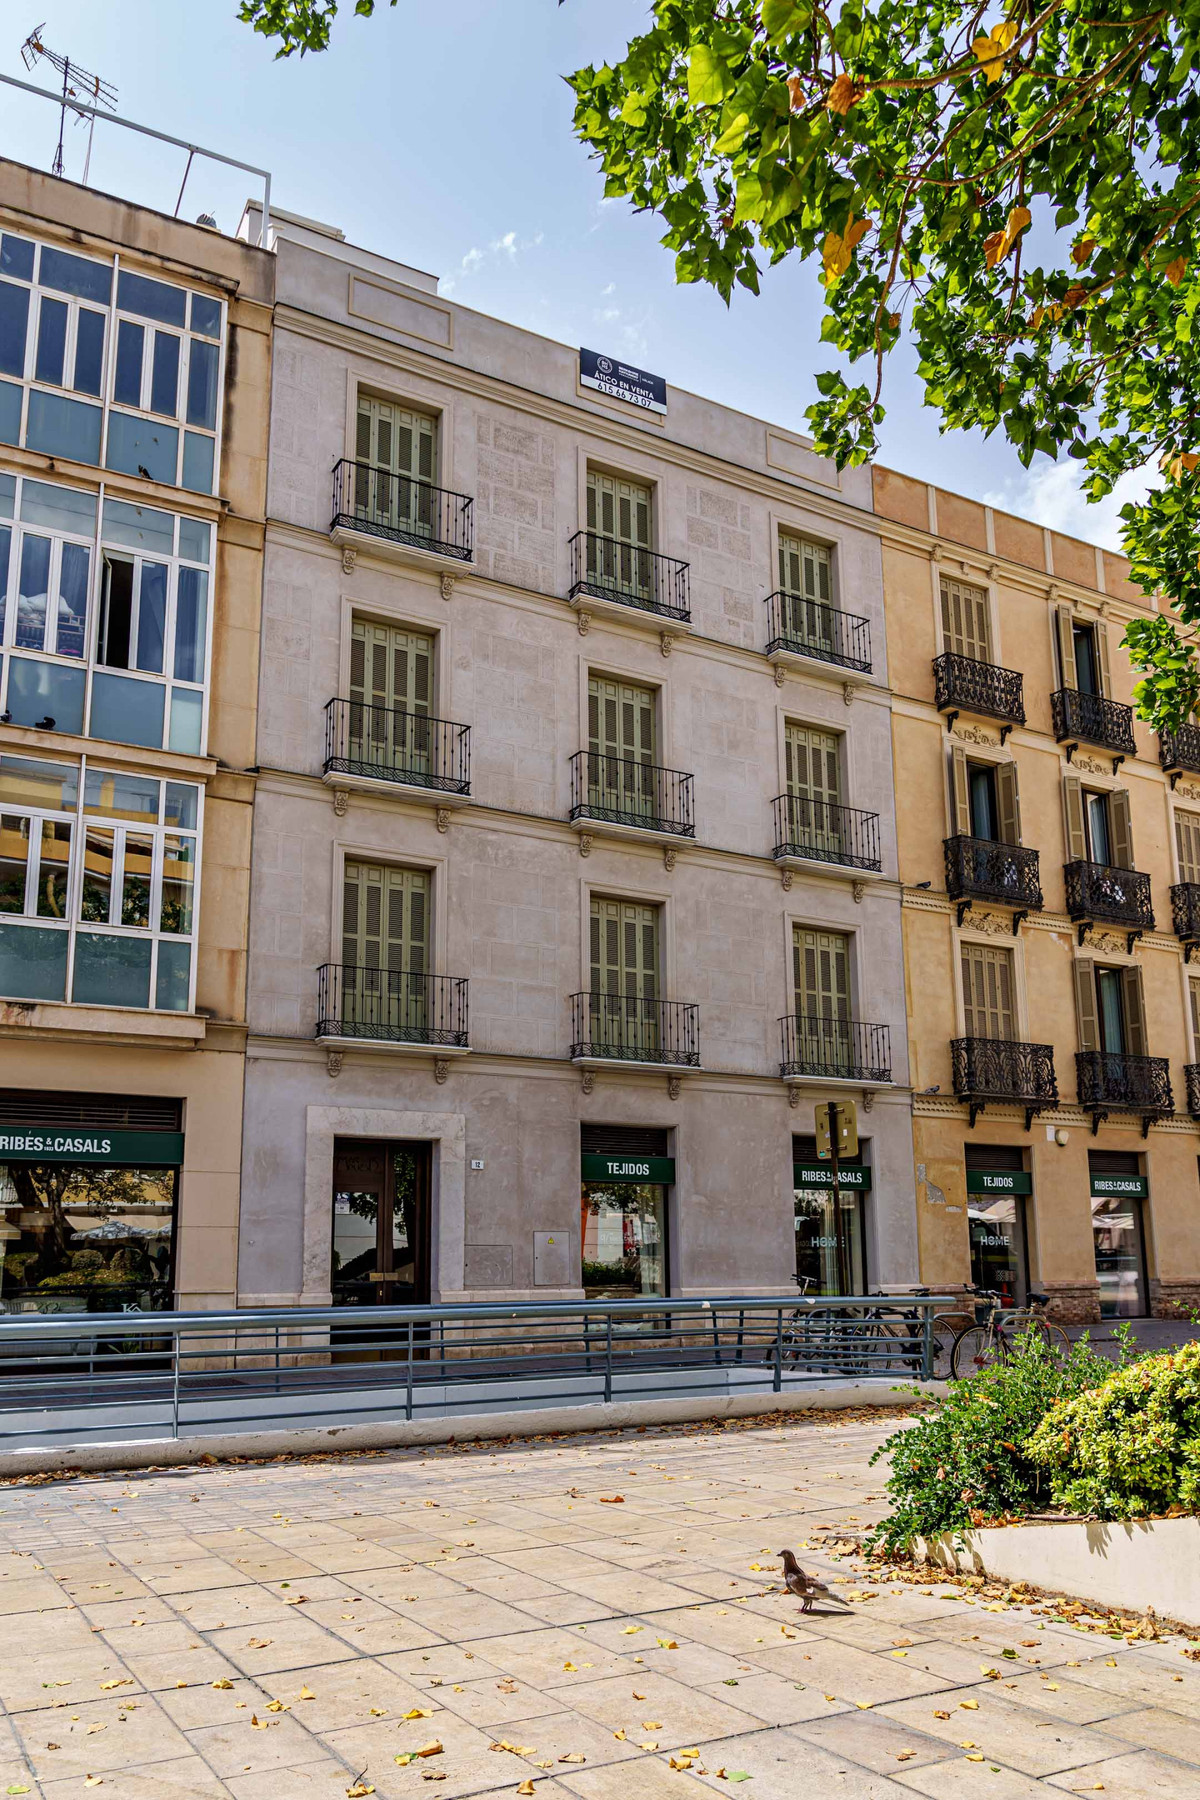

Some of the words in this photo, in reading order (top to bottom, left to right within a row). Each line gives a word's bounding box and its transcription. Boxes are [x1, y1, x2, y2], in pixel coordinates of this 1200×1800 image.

[594, 370, 618, 385] ÁTICO
[619, 381, 629, 390] EN
[631, 385, 654, 399] VENTA
[597, 382, 613, 393] 615
[616, 389, 626, 398] 66
[629, 393, 639, 403] 73
[641, 398, 651, 408] 07
[54, 1138, 111, 1153] CASALS
[607, 1162, 650, 1175] TEJIDOS
[983, 1176, 1014, 1187] TEJIDOS
[981, 1235, 1011, 1246] HOME
